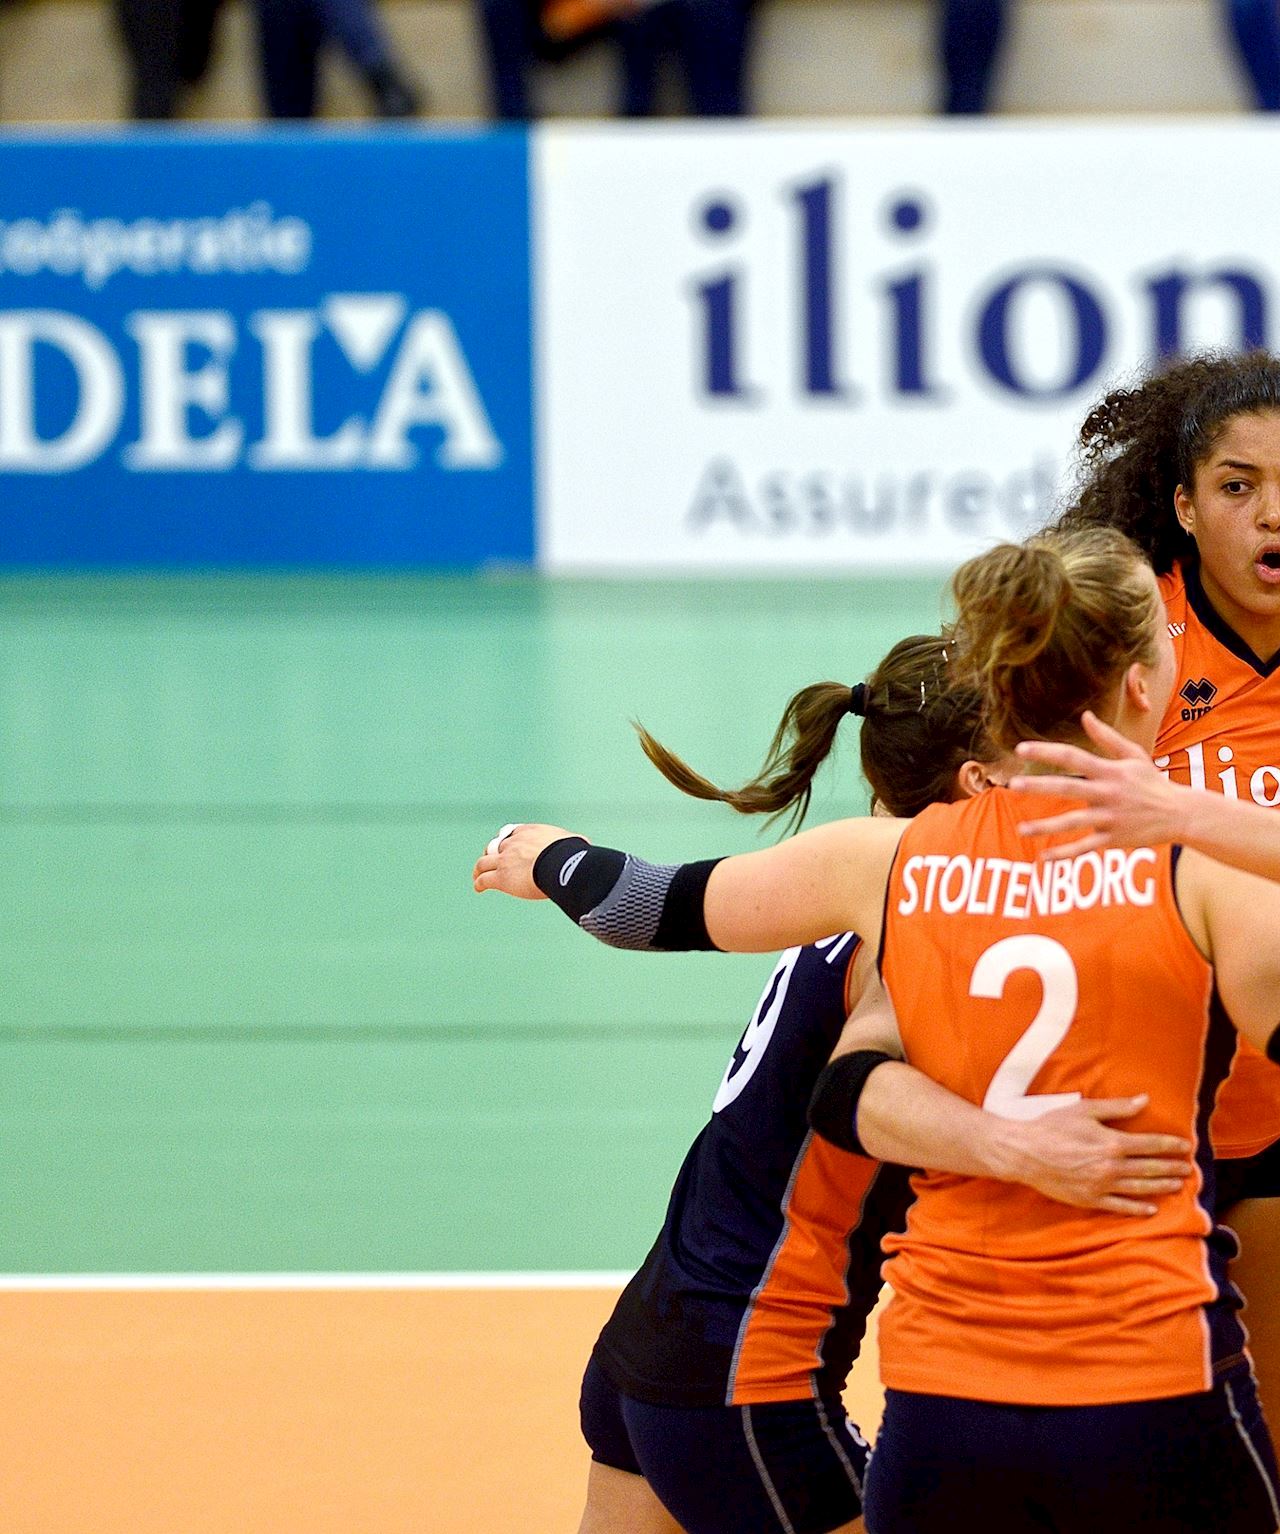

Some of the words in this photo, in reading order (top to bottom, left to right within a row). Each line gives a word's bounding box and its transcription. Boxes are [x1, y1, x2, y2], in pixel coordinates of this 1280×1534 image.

[0, 200, 312, 290] oöperatie
[0, 306, 503, 474] DELA
[898, 847, 1156, 918] STOLTENBORG
[712, 945, 802, 1114] 9
[968, 933, 1083, 1122] 2
